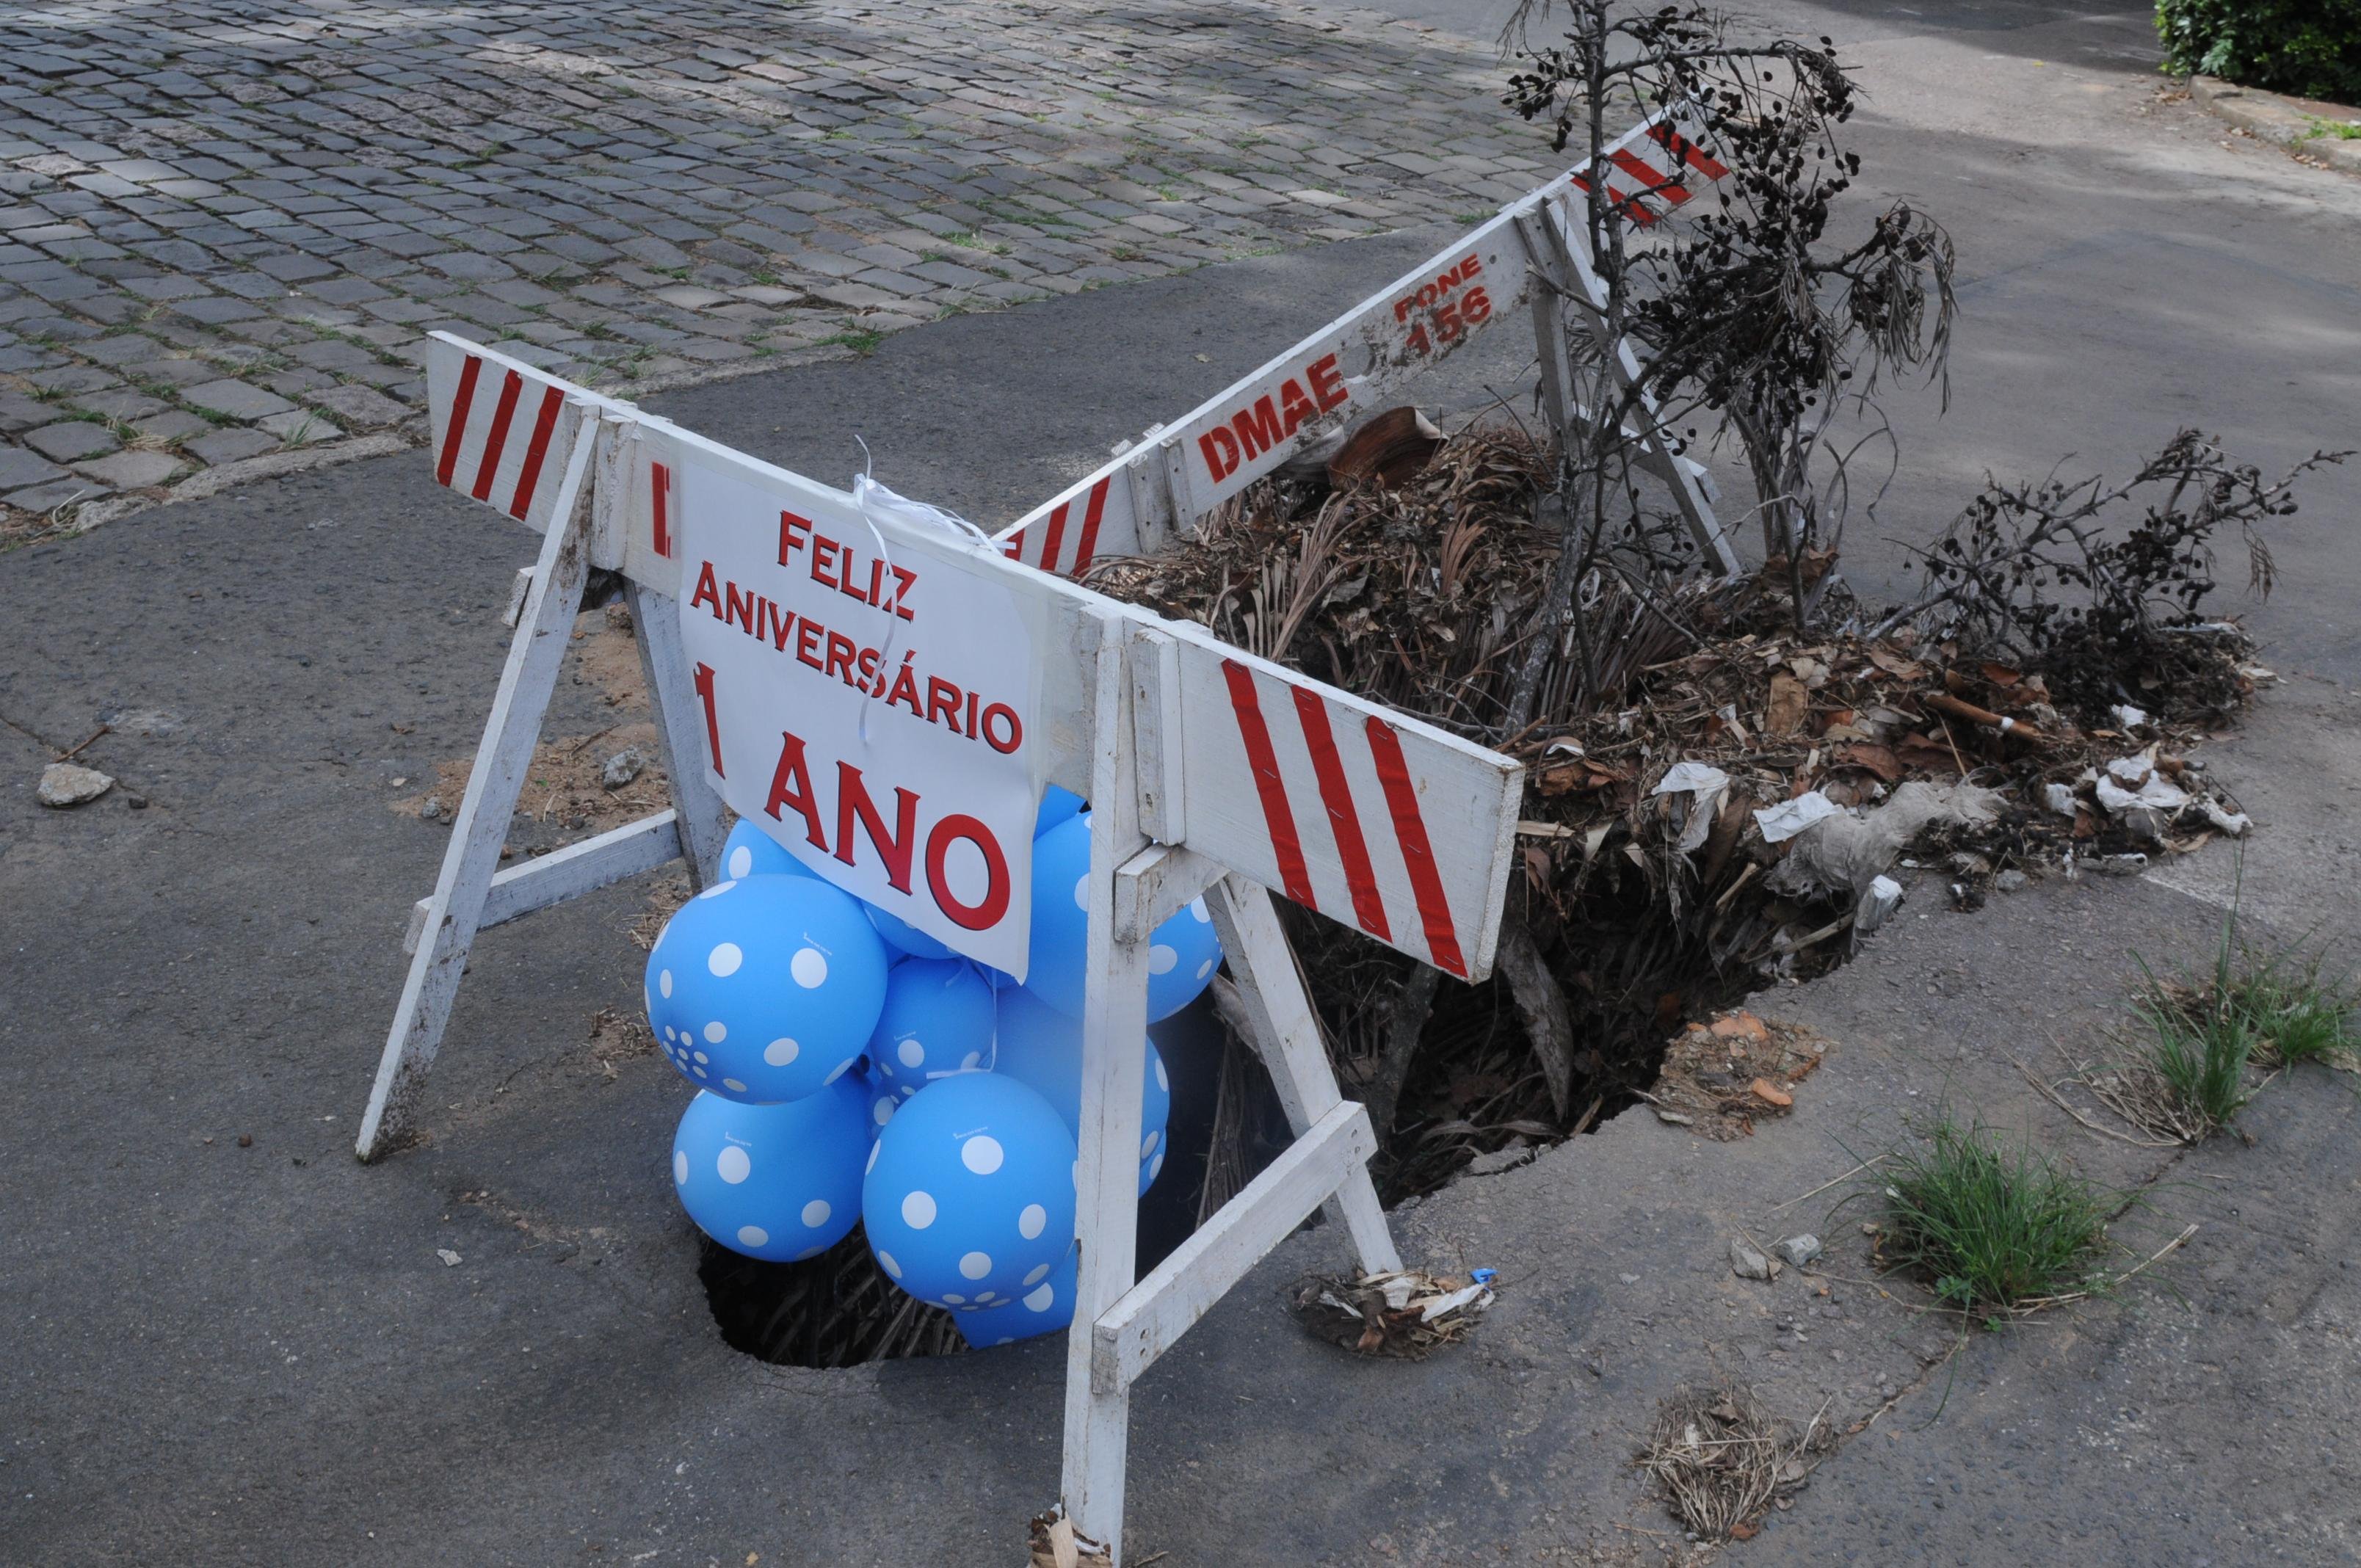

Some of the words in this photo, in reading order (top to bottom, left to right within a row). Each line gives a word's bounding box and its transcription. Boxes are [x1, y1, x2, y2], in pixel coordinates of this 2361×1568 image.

[1394, 252, 1482, 323] FONE
[1405, 286, 1492, 355] 156
[1197, 352, 1349, 484] DMAE
[777, 509, 918, 623] FELIZ
[689, 559, 1023, 755] ANIVERSÁRIO
[693, 661, 725, 780] 1
[764, 730, 1011, 932] ANO
